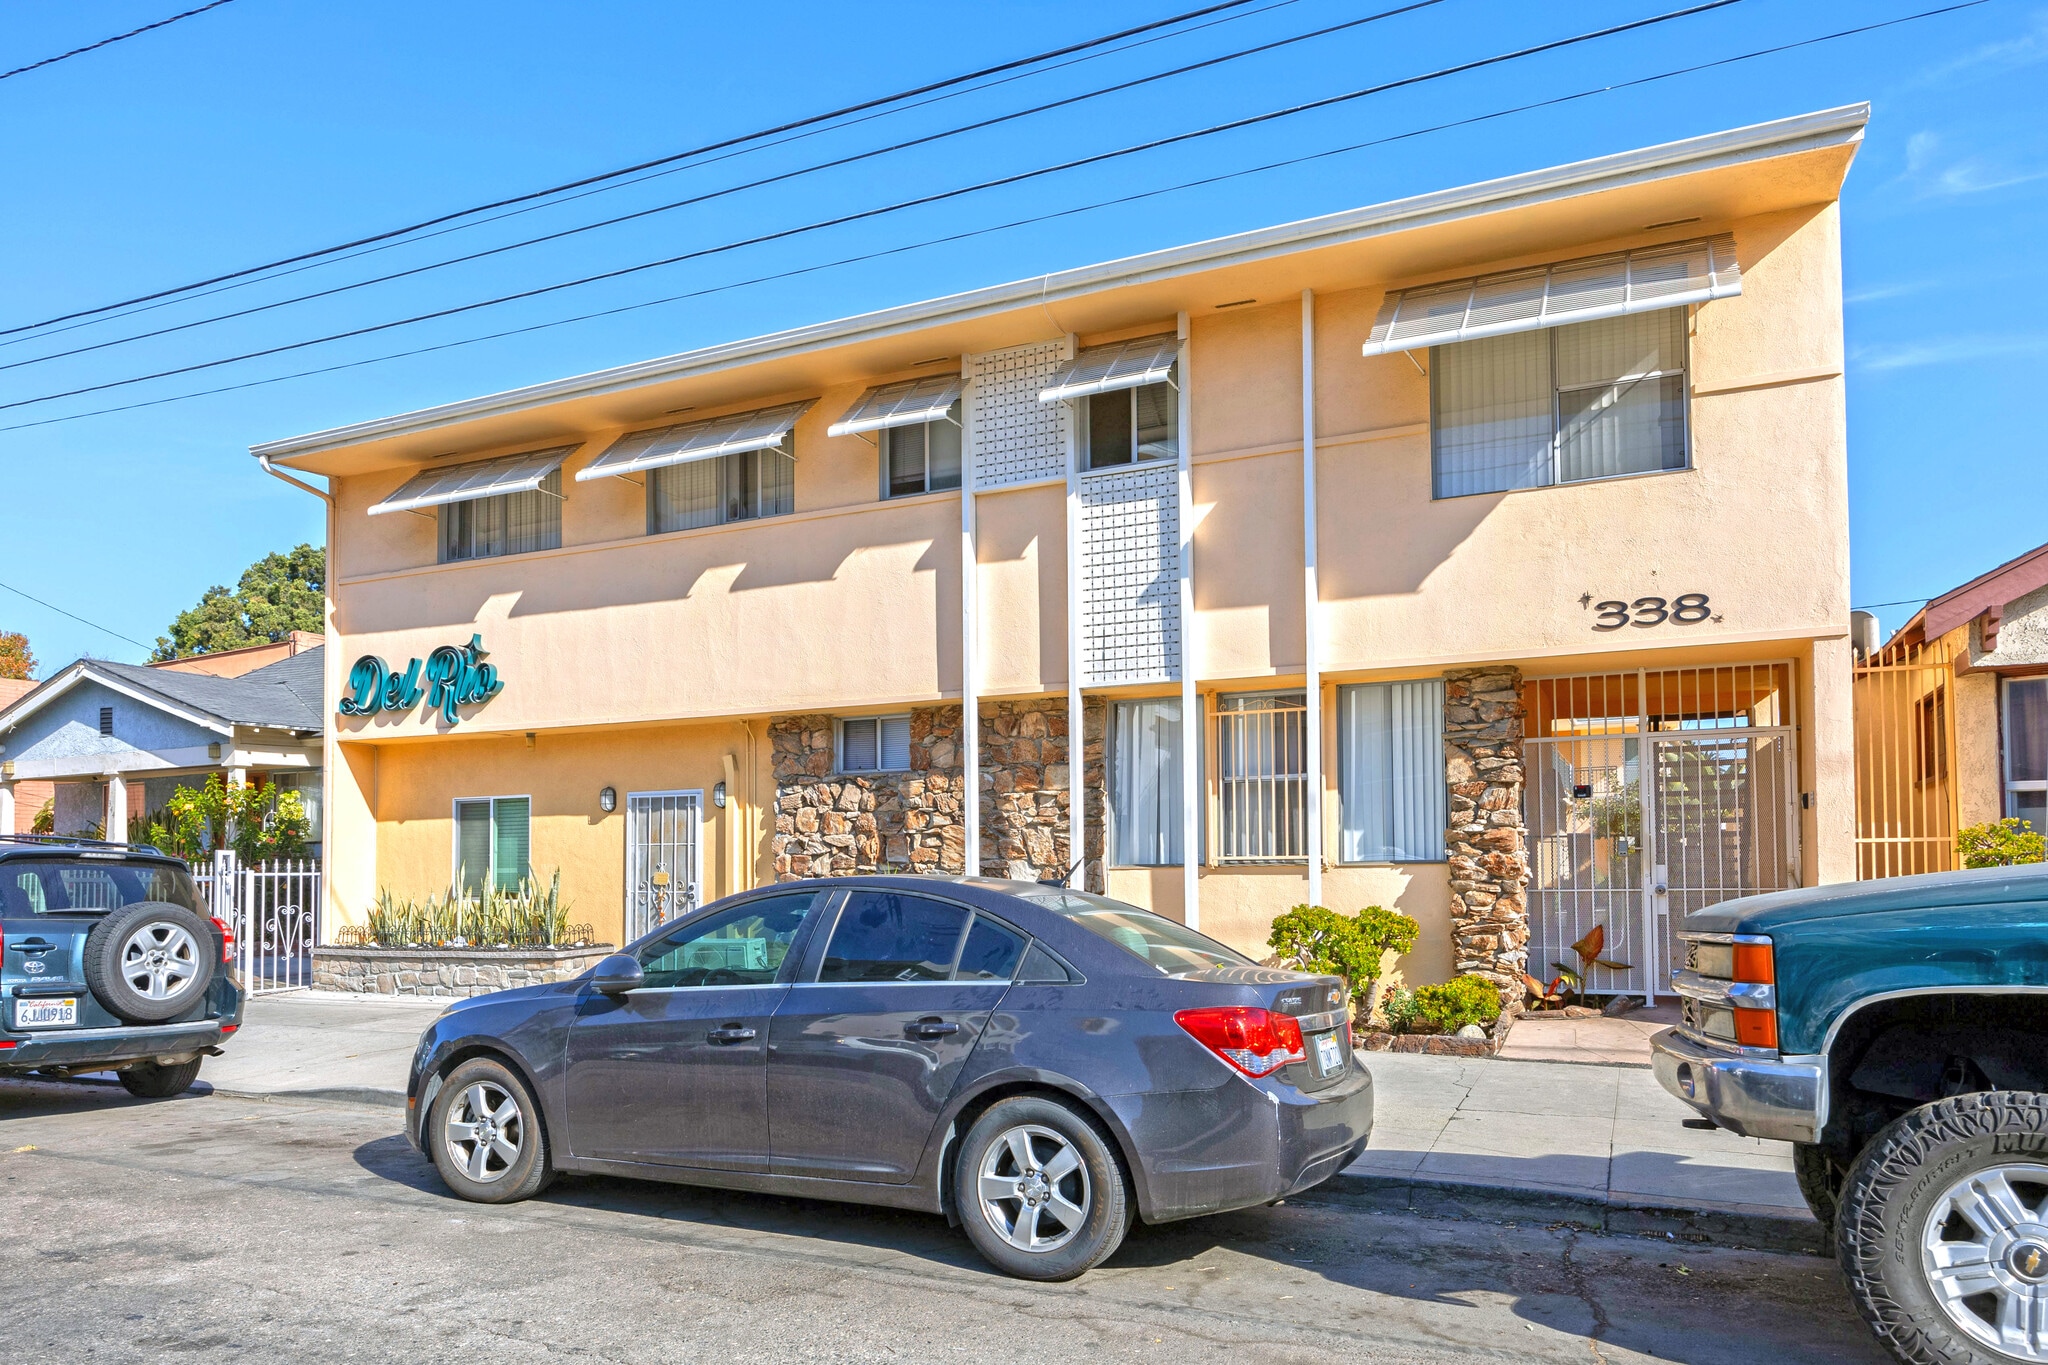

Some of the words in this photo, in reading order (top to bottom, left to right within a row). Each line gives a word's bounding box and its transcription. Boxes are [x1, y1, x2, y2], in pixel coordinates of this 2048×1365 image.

[1595, 593, 1711, 630] 338
[339, 655, 424, 716] Del
[426, 633, 505, 724] Rio
[29, 1000, 64, 1009] California
